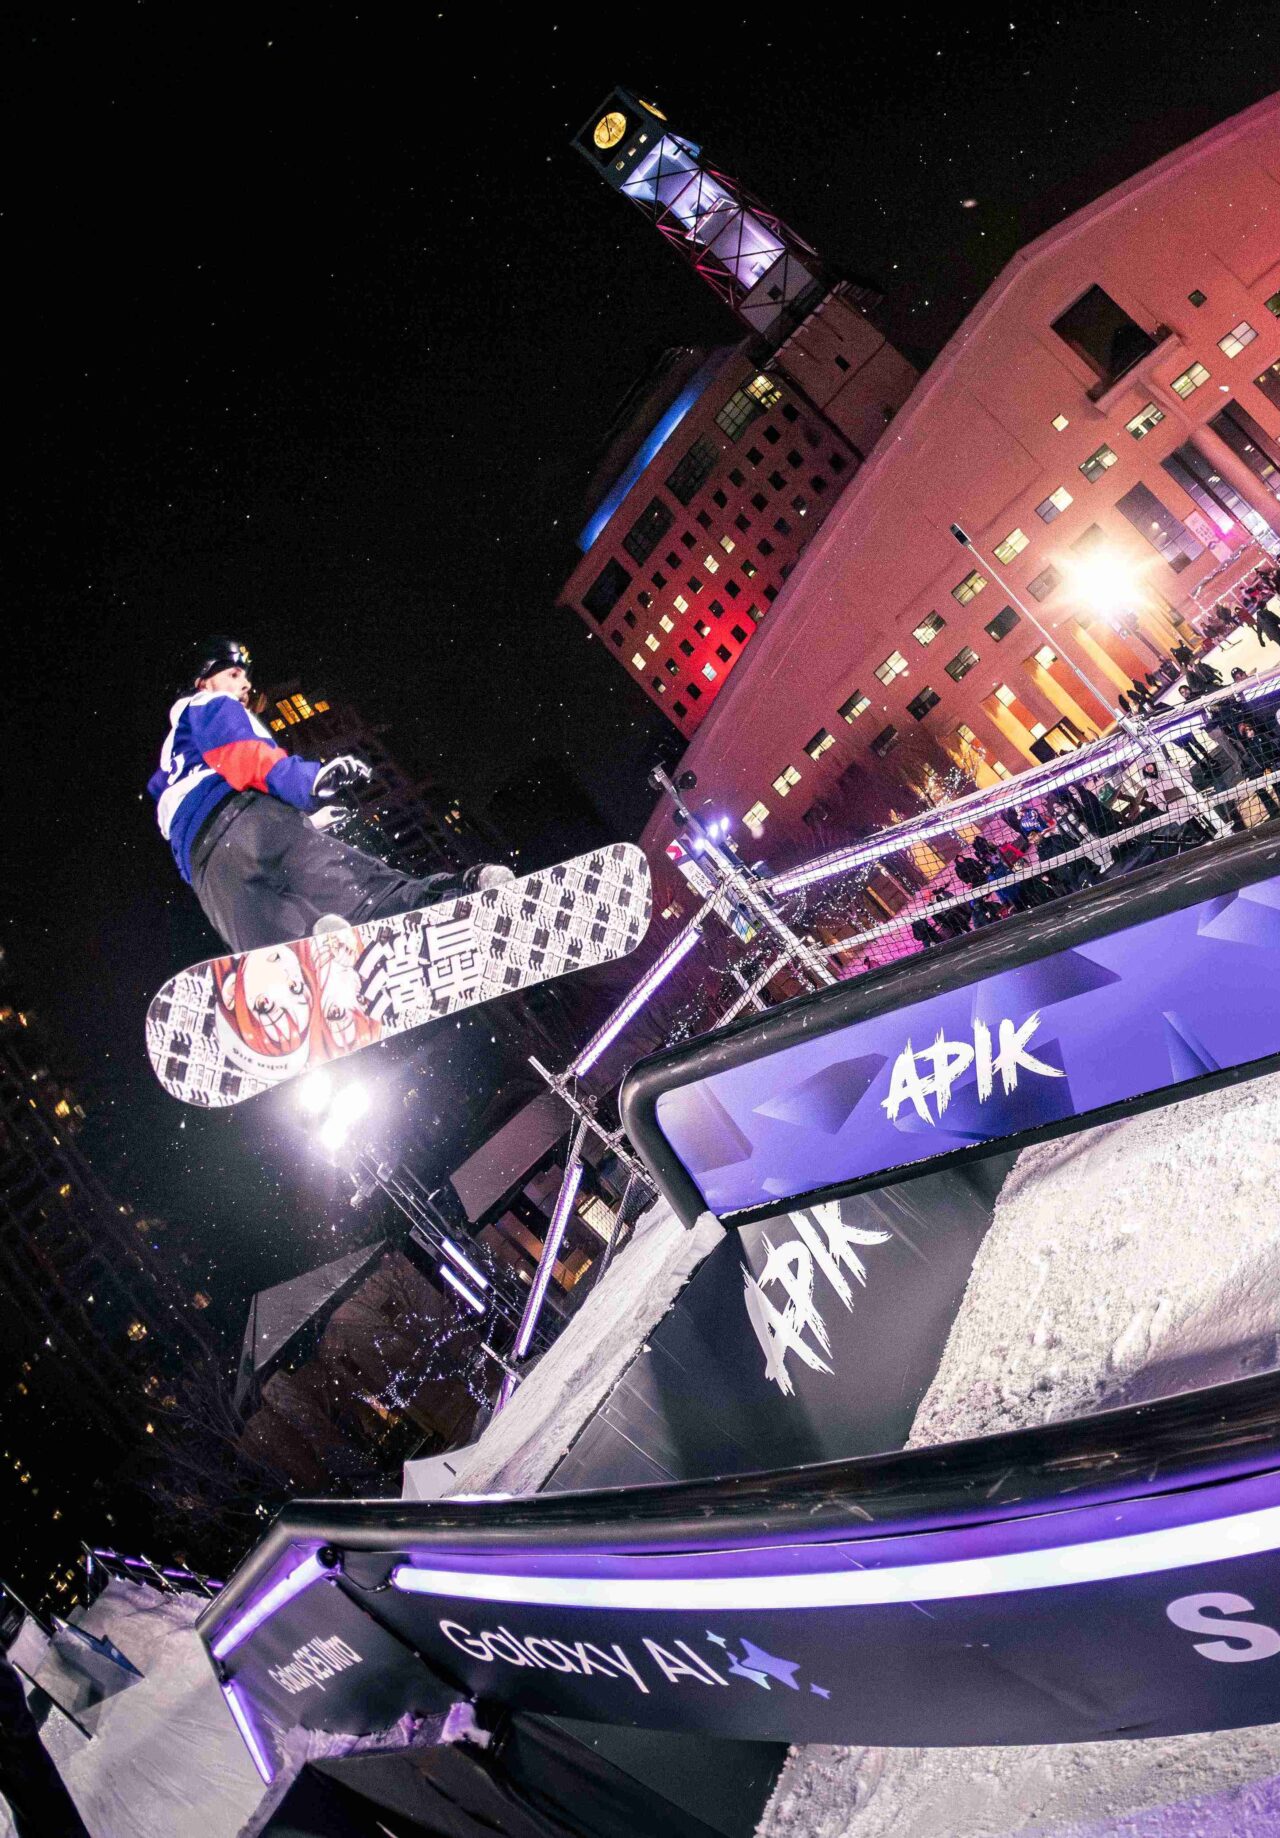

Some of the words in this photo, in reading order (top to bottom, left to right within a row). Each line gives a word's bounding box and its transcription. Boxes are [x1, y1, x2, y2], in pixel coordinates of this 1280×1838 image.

[880, 1010, 1068, 1127] APIK
[292, 1645, 335, 1680] S25
[307, 1634, 363, 1672] Ultra
[439, 1620, 650, 1693] Galaxy
[642, 1638, 729, 1686] AI
[268, 1660, 326, 1694] Galaxy
